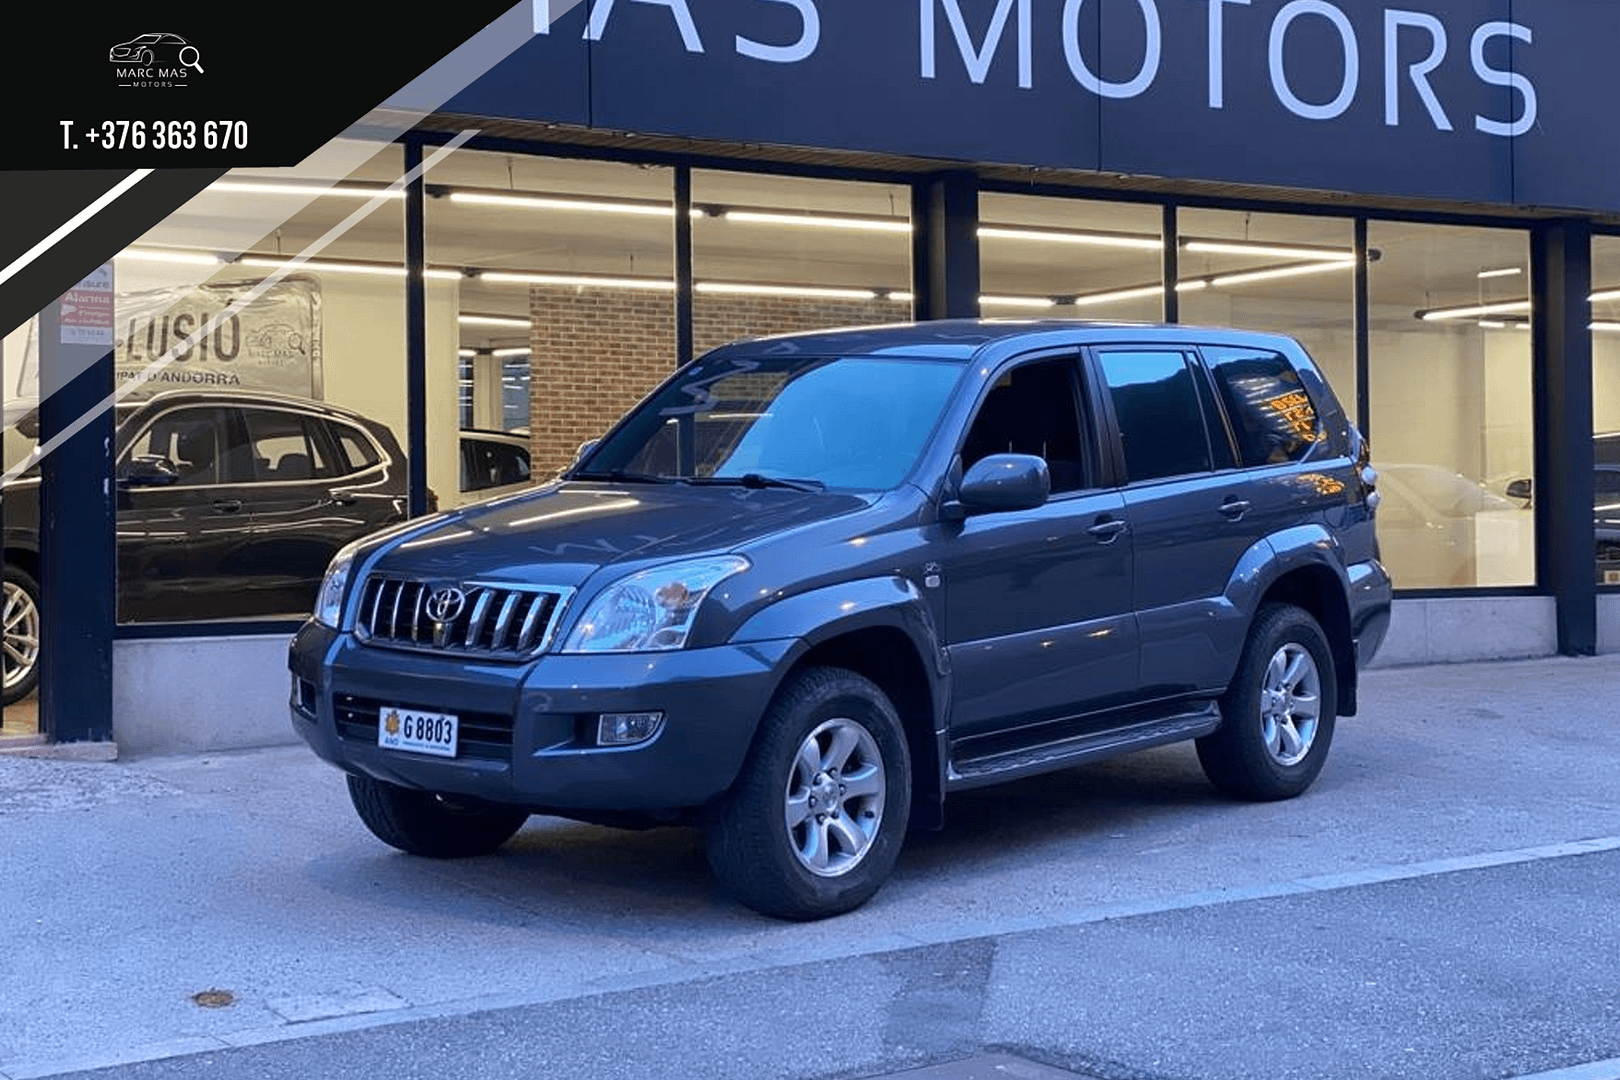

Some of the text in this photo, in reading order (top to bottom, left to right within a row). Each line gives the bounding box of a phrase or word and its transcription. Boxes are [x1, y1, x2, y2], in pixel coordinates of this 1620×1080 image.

[918, 0, 1538, 137] MOTORS
[404, 715, 452, 744] G 8803
